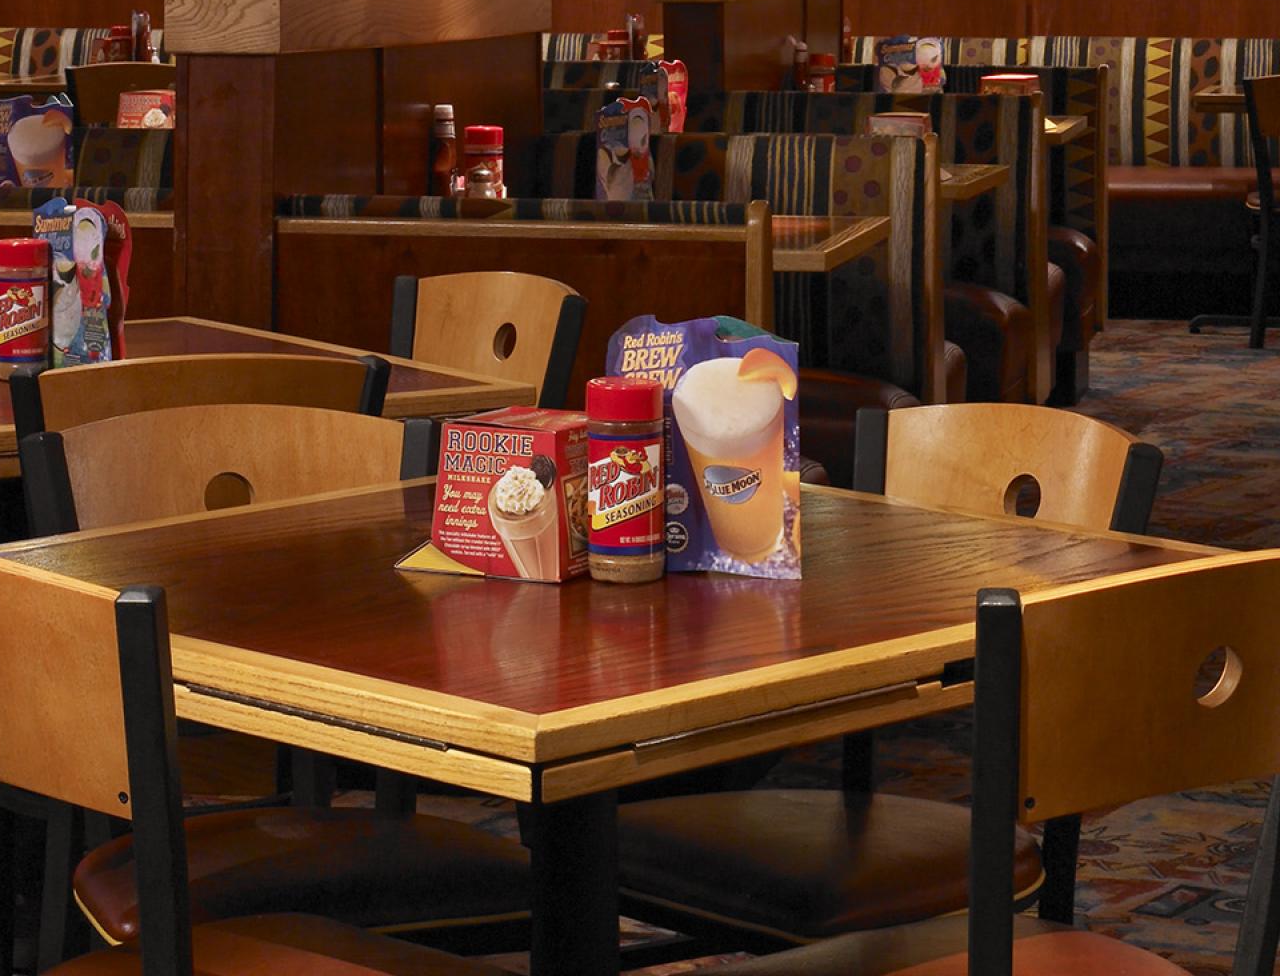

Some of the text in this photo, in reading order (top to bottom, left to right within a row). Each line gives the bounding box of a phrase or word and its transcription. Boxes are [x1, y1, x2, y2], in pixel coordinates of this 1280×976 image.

[35, 215, 73, 233] Summer
[624, 331, 684, 350] Red Robin's
[621, 344, 683, 373] BREW
[448, 429, 534, 457] ROOKIE
[443, 453, 508, 475] MAGIC
[447, 474, 492, 484] MILKSHAKE
[589, 461, 620, 493] RED
[731, 471, 761, 493] MOON
[442, 484, 484, 504] You may
[598, 466, 660, 512] ROBIN
[438, 500, 461, 513] need
[604, 495, 658, 525] SEASONING
[444, 515, 479, 532] innings
